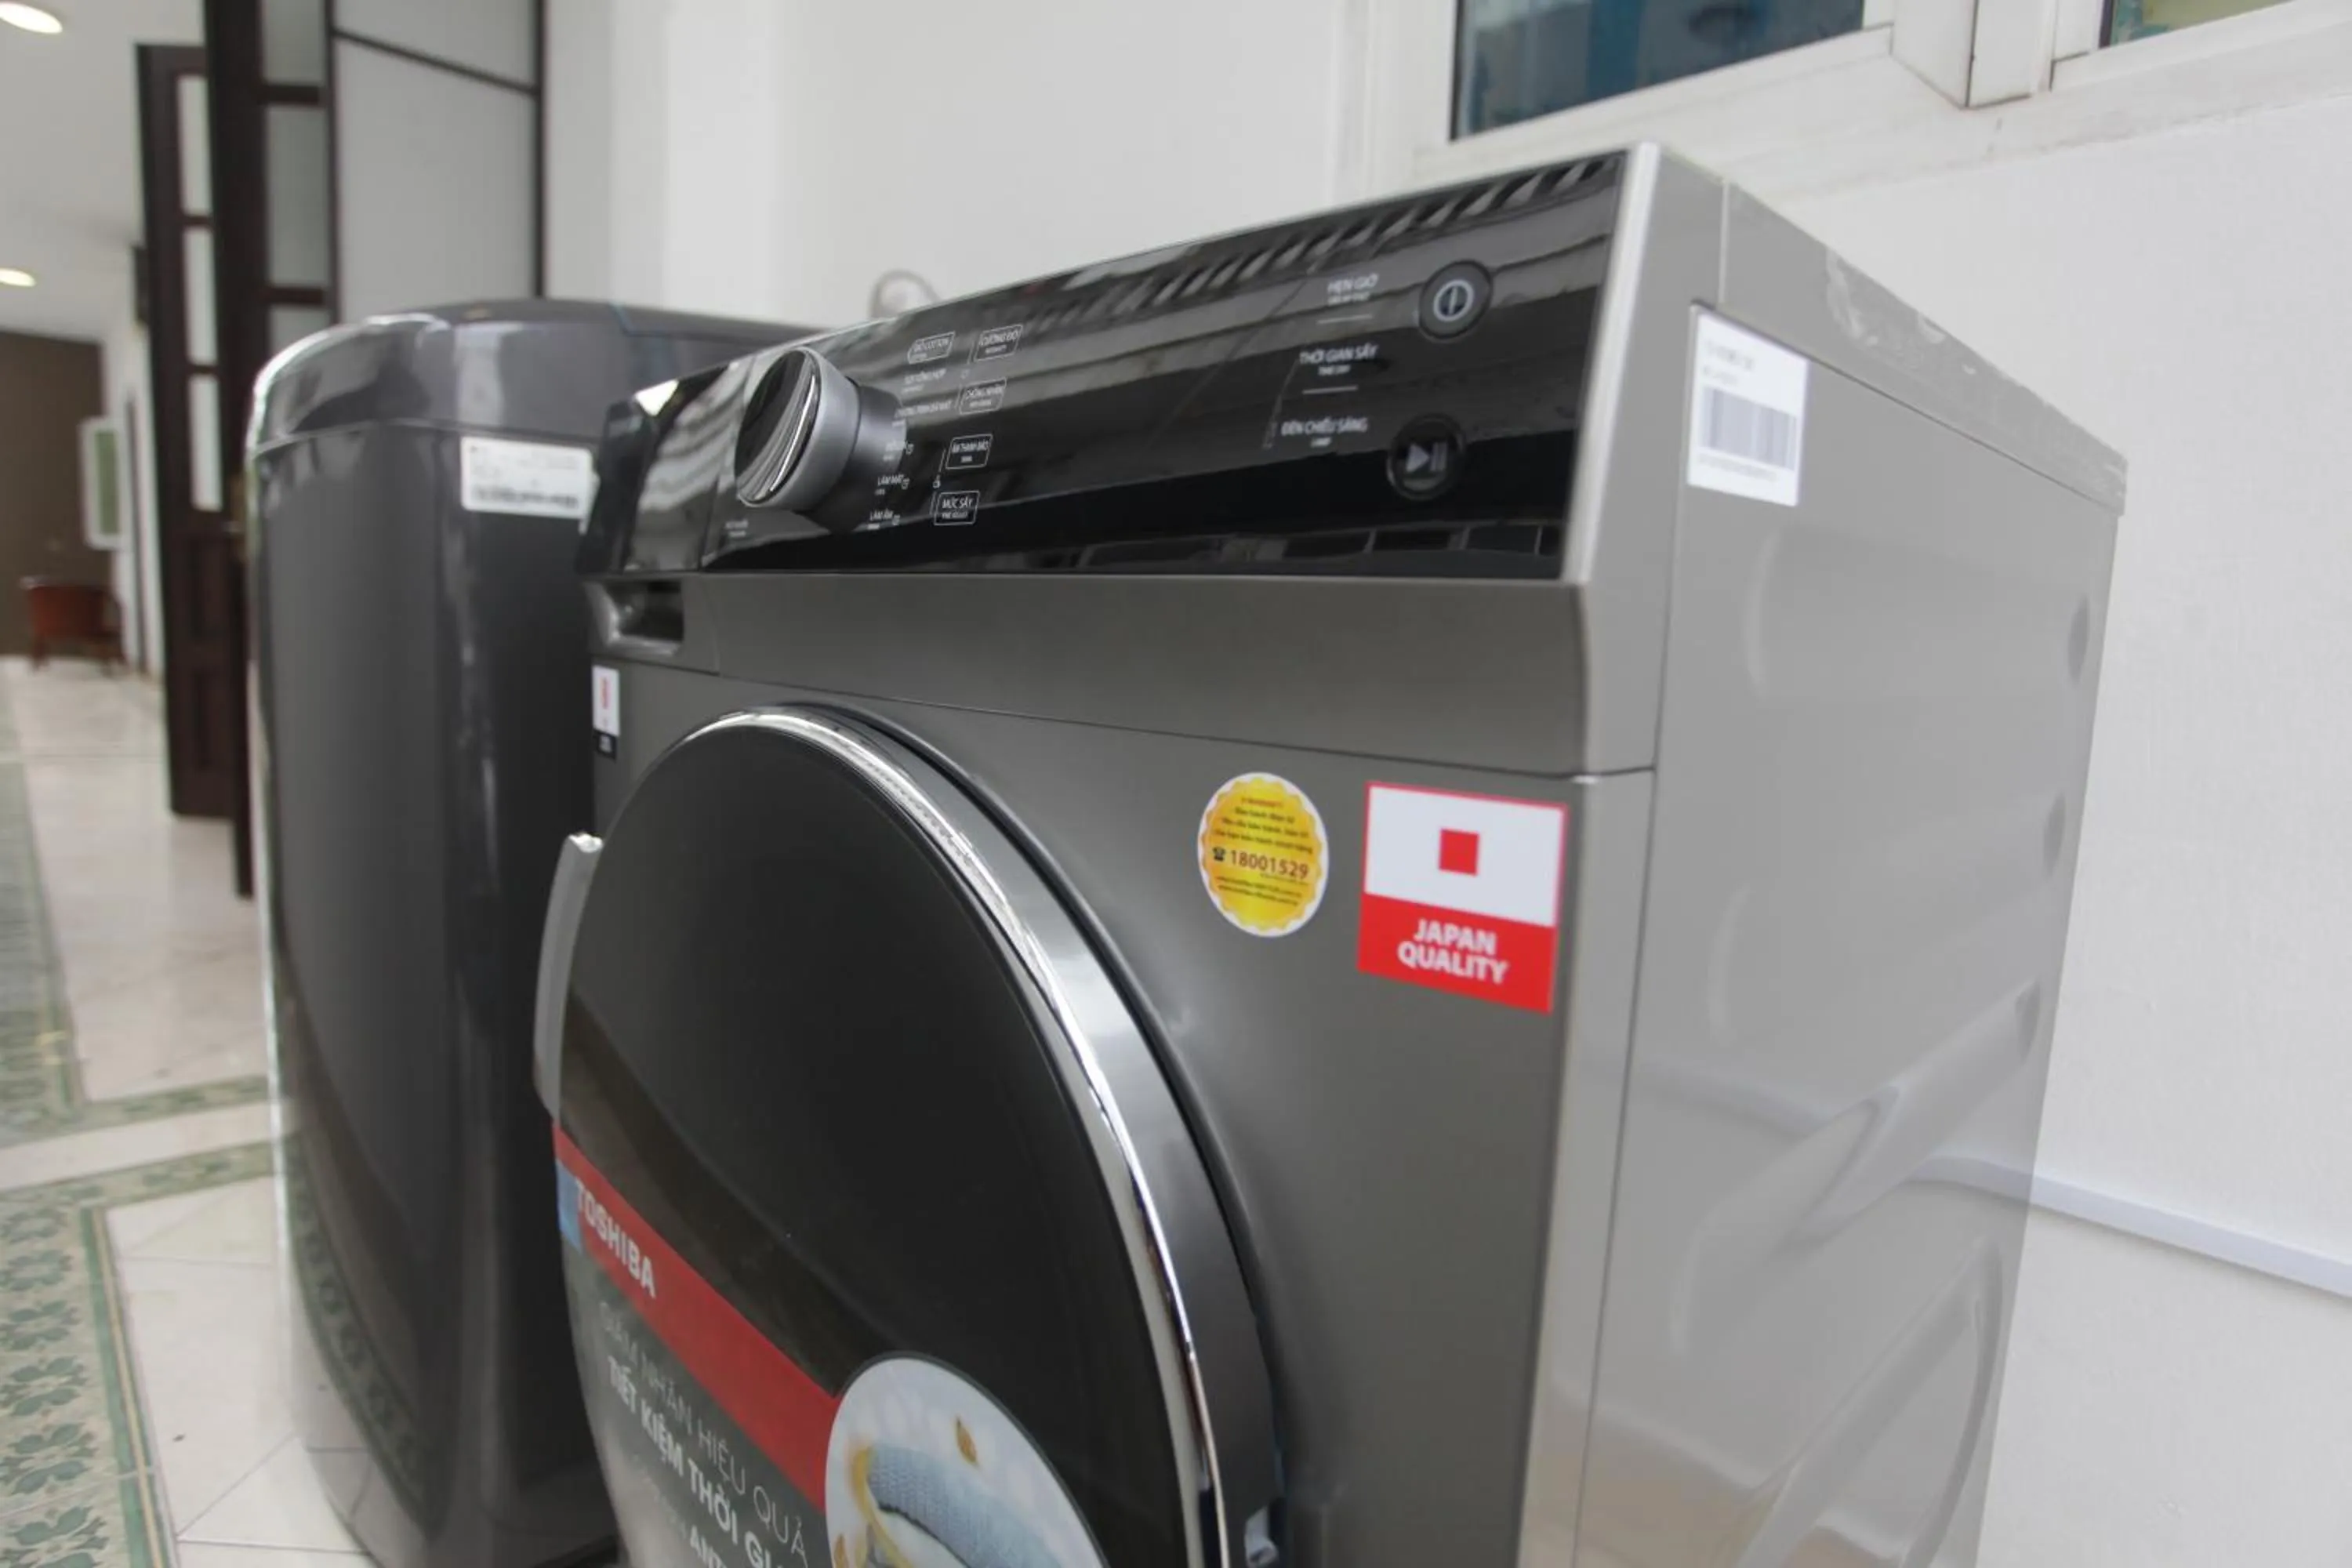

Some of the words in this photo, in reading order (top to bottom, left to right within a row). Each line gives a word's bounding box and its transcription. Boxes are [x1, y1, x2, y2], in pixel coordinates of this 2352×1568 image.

[1230, 849, 1309, 880] 18001529
[1397, 941, 1508, 985] QUALITY
[1414, 918, 1497, 956] JAPAN
[575, 1178, 656, 1300] TOSHIBA
[641, 1398, 684, 1478] KIỆM
[688, 1457, 739, 1546] THỜI
[746, 1531, 783, 1568] GI
[698, 1417, 746, 1496] HIỆU
[753, 1485, 808, 1568] QUẢ
